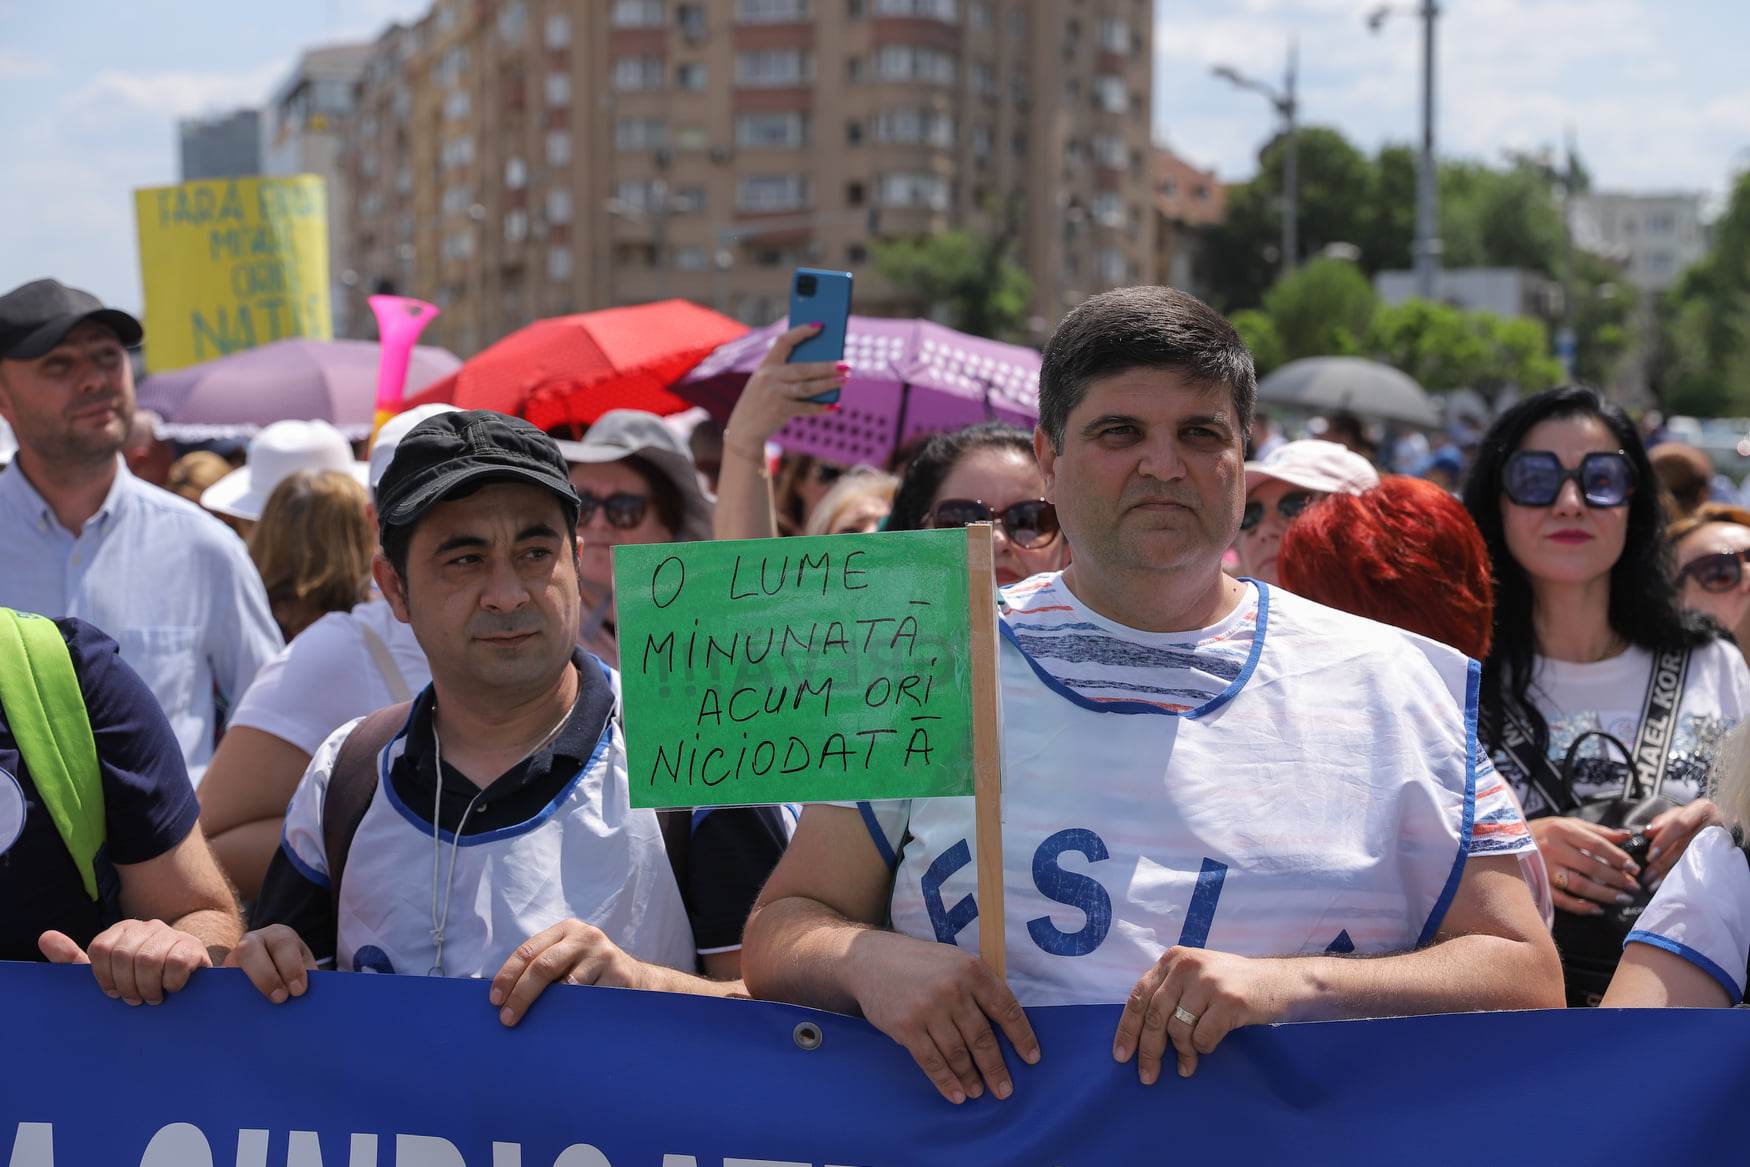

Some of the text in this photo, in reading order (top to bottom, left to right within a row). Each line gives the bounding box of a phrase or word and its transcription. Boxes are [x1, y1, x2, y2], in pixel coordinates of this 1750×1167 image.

[652, 551, 868, 608] O LUME
[696, 676, 832, 727] ACUM
[1652, 648, 1682, 710] KOR
